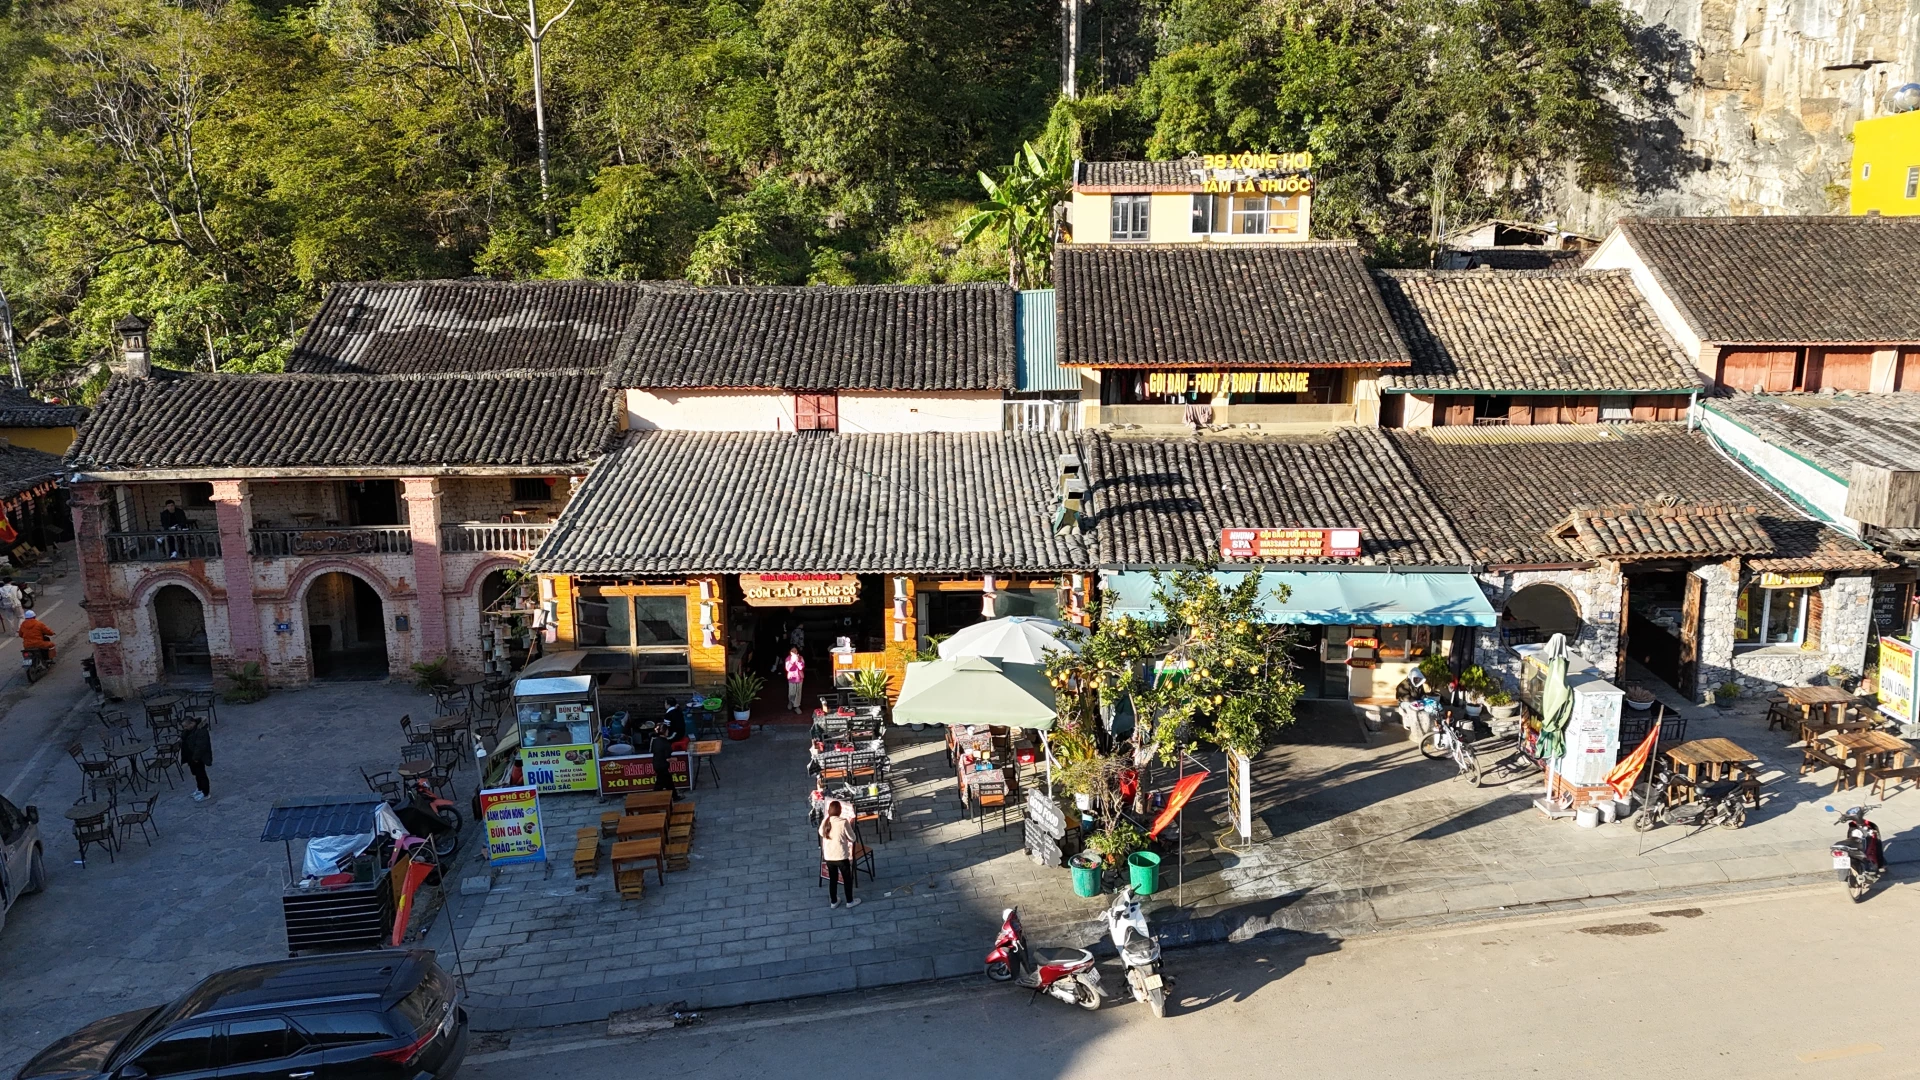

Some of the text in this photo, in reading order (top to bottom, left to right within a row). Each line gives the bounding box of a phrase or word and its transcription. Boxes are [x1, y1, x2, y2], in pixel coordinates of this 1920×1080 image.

[1203, 150, 1312, 169] 38 XÔNG HƠI
[1236, 177, 1254, 193] LÁ
[1261, 174, 1311, 192] THUỐC
[1195, 372, 1220, 393] FOOT
[1222, 373, 1230, 393] &
[1231, 372, 1258, 393] BODY
[1259, 372, 1309, 393] MASSAGE
[1229, 531, 1255, 540] NHUNG
[1232, 540, 1251, 549] SPA
[749, 586, 770, 598] CƠM
[804, 582, 840, 596] THẮNG
[541, 749, 561, 758] SÁNG
[527, 767, 555, 785] BÚN
[624, 763, 645, 777] BÁNH
[608, 778, 629, 788] XÔI
[672, 773, 688, 783] ẮC
[500, 792, 517, 801] PHỐ
[1029, 796, 1043, 814] GOOD
[1043, 807, 1059, 827] FOOD
[490, 822, 522, 838] BÚN CHẢ
[491, 840, 511, 854] CHÁO
